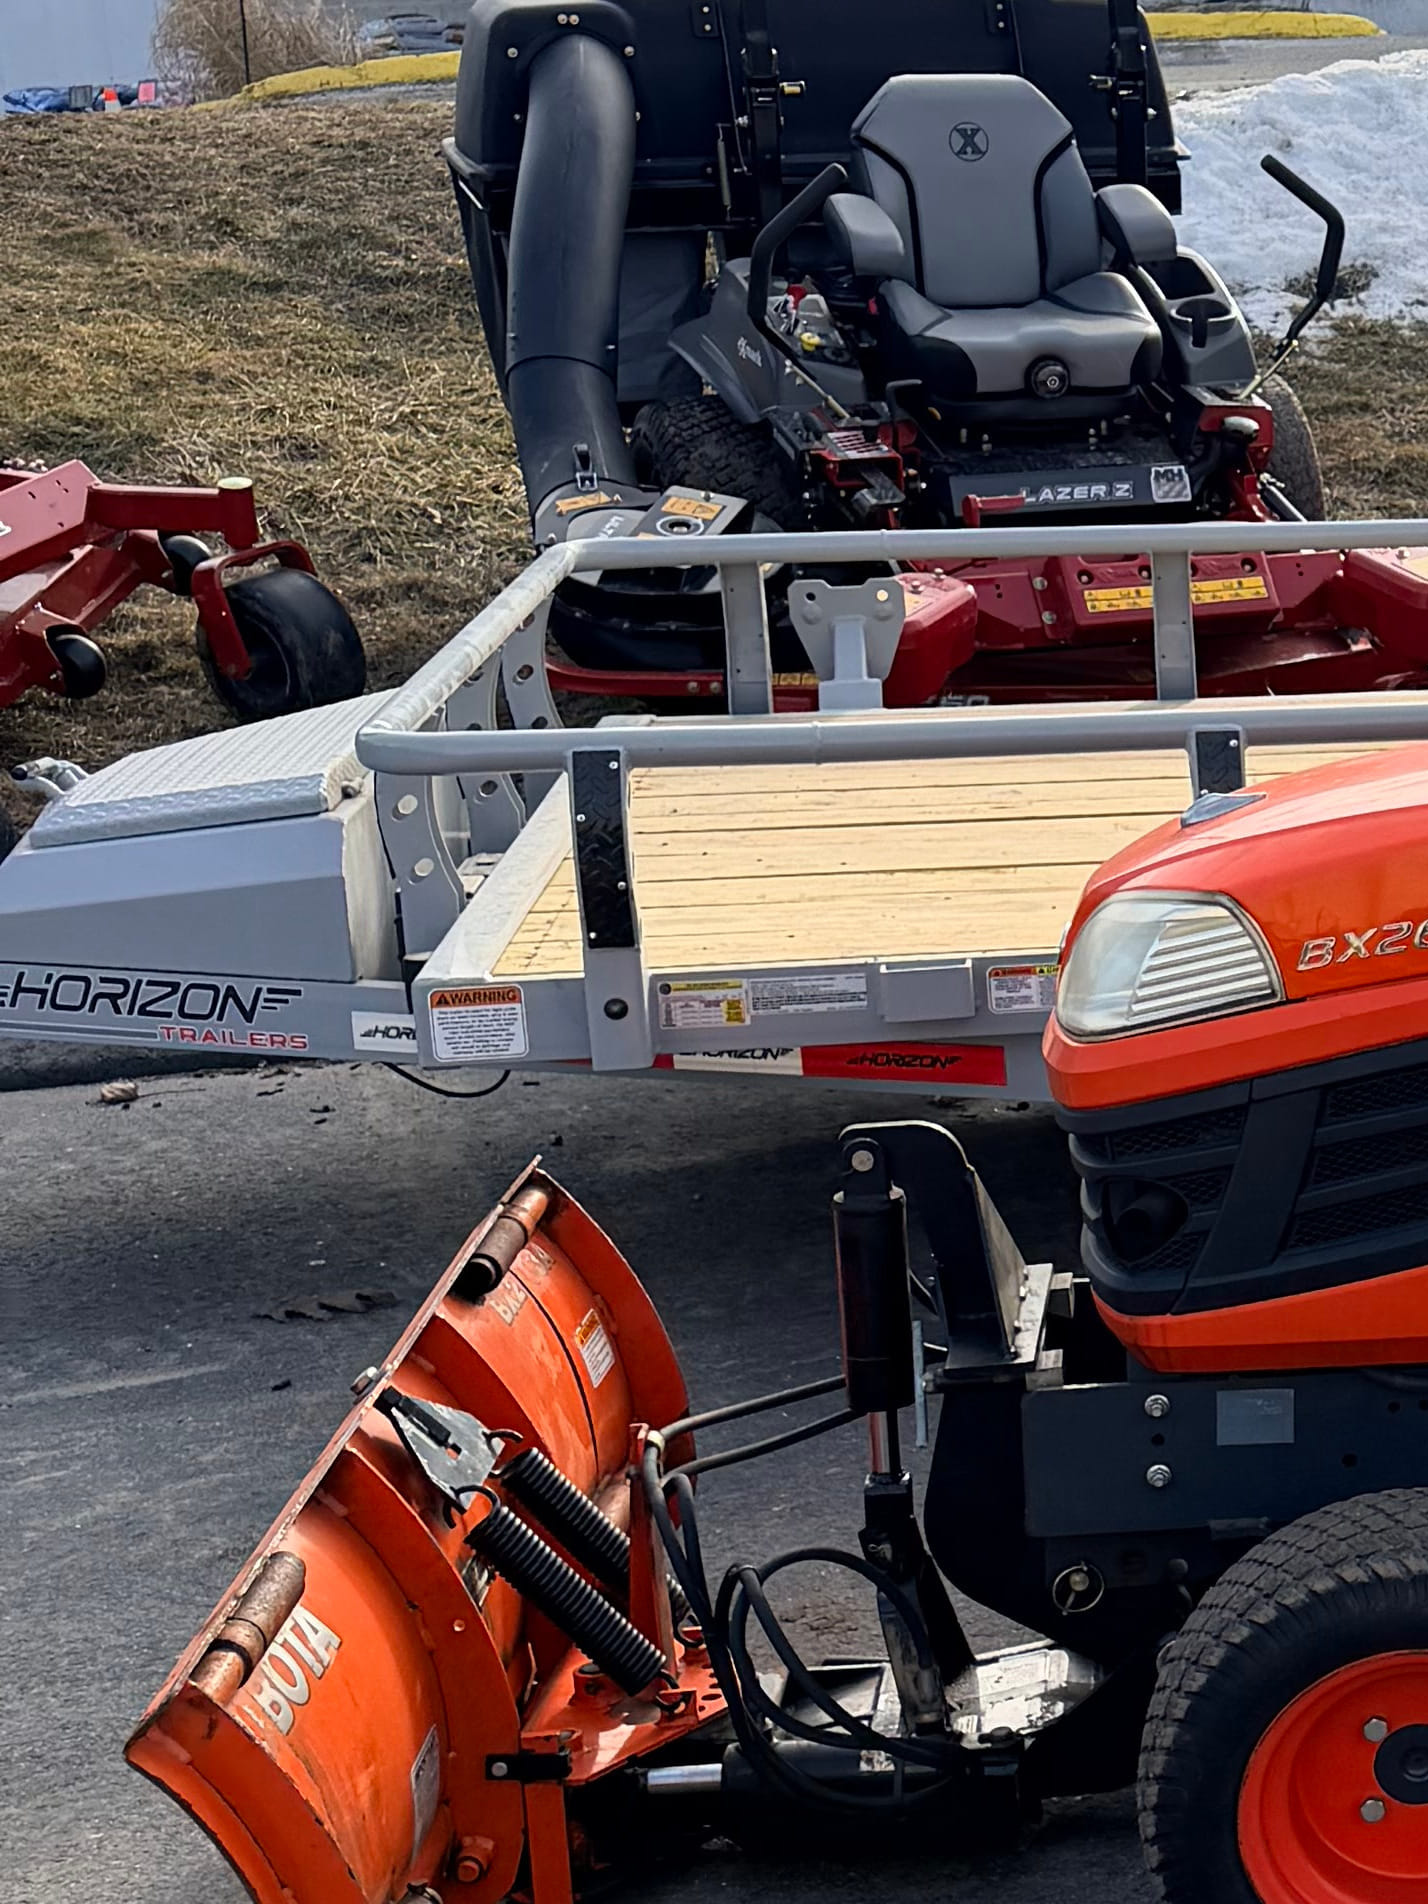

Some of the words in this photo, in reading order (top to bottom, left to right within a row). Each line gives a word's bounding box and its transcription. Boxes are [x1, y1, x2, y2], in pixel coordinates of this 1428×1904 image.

[1020, 482, 1108, 504] LAZER
[1113, 481, 1133, 499] Z
[10, 971, 263, 1024] HORIZON
[450, 988, 517, 1005] WARNING
[159, 1025, 308, 1049] TRAILERS
[859, 1052, 953, 1070] HORIZON
